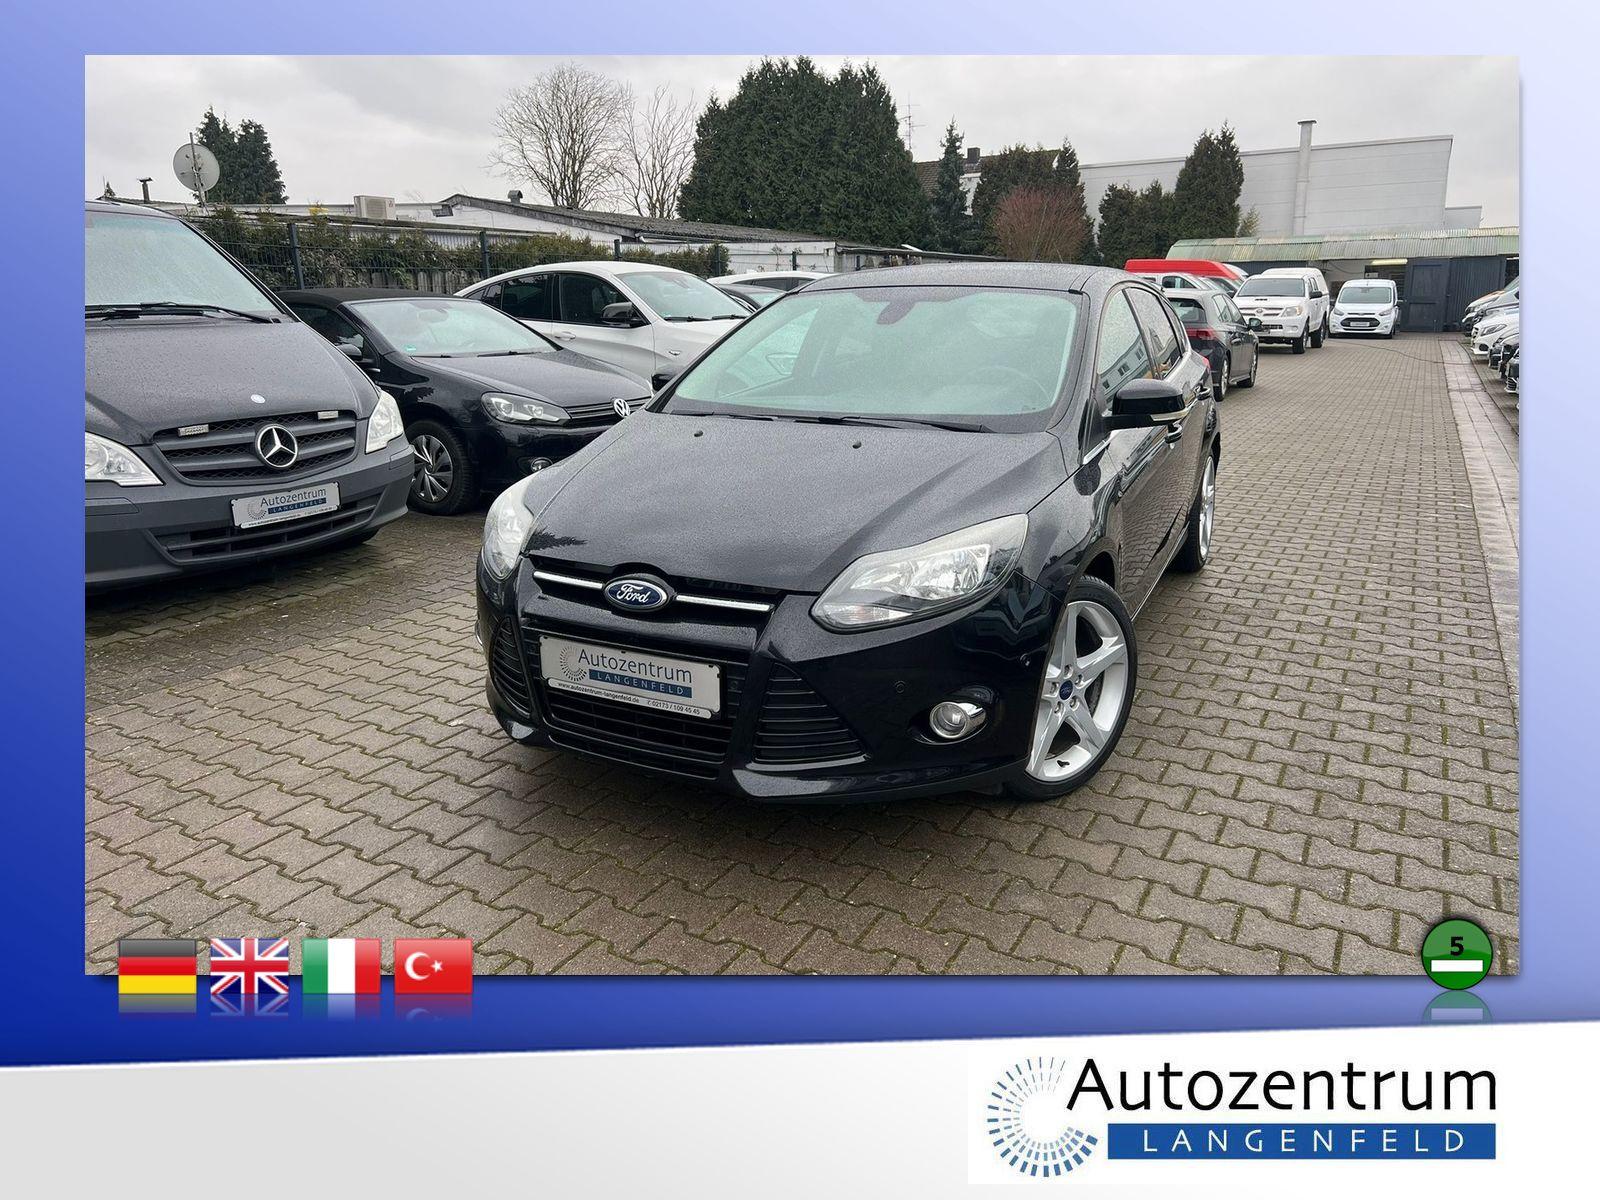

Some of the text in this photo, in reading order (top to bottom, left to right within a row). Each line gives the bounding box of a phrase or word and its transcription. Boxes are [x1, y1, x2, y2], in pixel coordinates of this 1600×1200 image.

[260, 488, 327, 507] Autozentrum
[273, 500, 323, 513] LANGENFELD
[616, 583, 649, 603] Ford
[578, 648, 692, 684] Autozentrum
[597, 670, 684, 695] LANGENFELD
